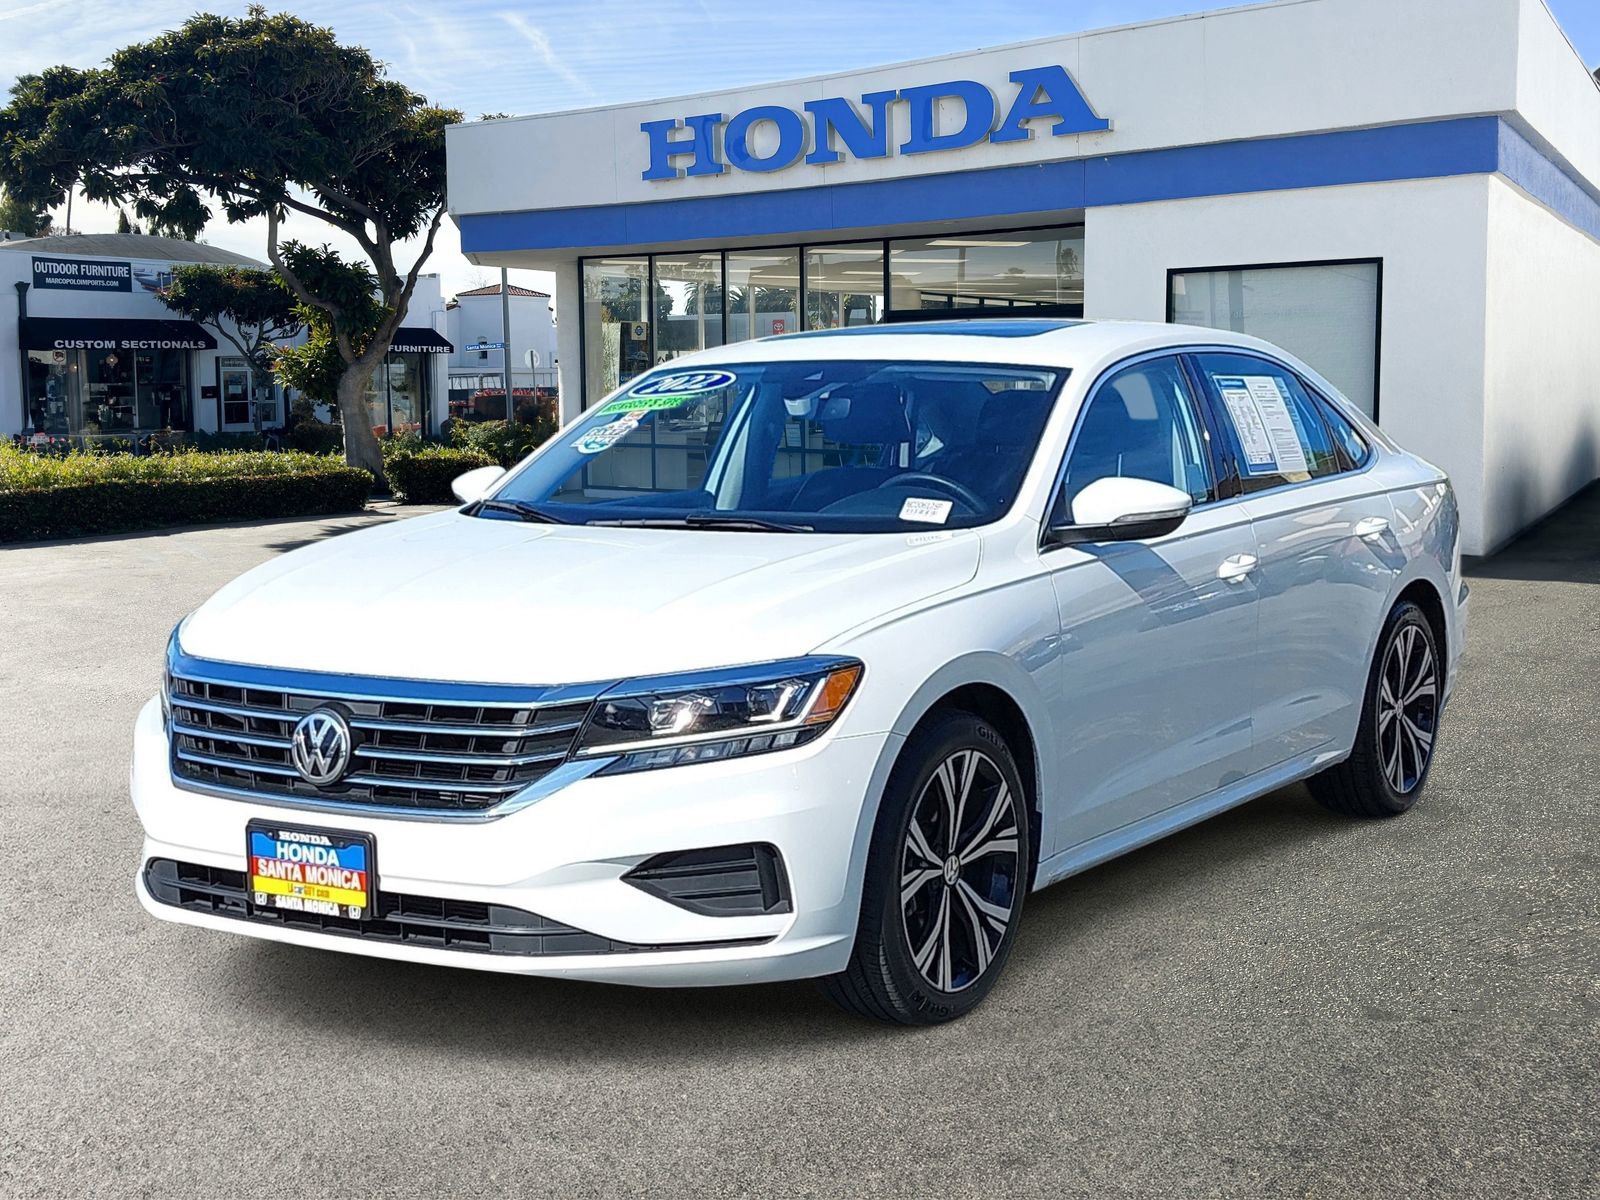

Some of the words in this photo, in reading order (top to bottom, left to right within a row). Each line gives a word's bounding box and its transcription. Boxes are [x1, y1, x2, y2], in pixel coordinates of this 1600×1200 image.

[641, 64, 1112, 181] HONDA
[34, 261, 79, 275] OUTDOOR
[80, 264, 130, 277] FURNITURE
[45, 277, 119, 287] MARCOPOLOIMPORTS.COM
[54, 339, 116, 349] CUSTOM
[121, 340, 206, 349] SECTIONALS
[388, 344, 450, 353] FURNITURE
[639, 373, 723, 394] 2022
[278, 831, 333, 846] HONDA
[276, 841, 340, 866] HONDA
[258, 859, 303, 883] SANTA
[305, 865, 361, 891] MONICA
[275, 895, 303, 912] SANTA
[304, 899, 340, 917] MONICA
